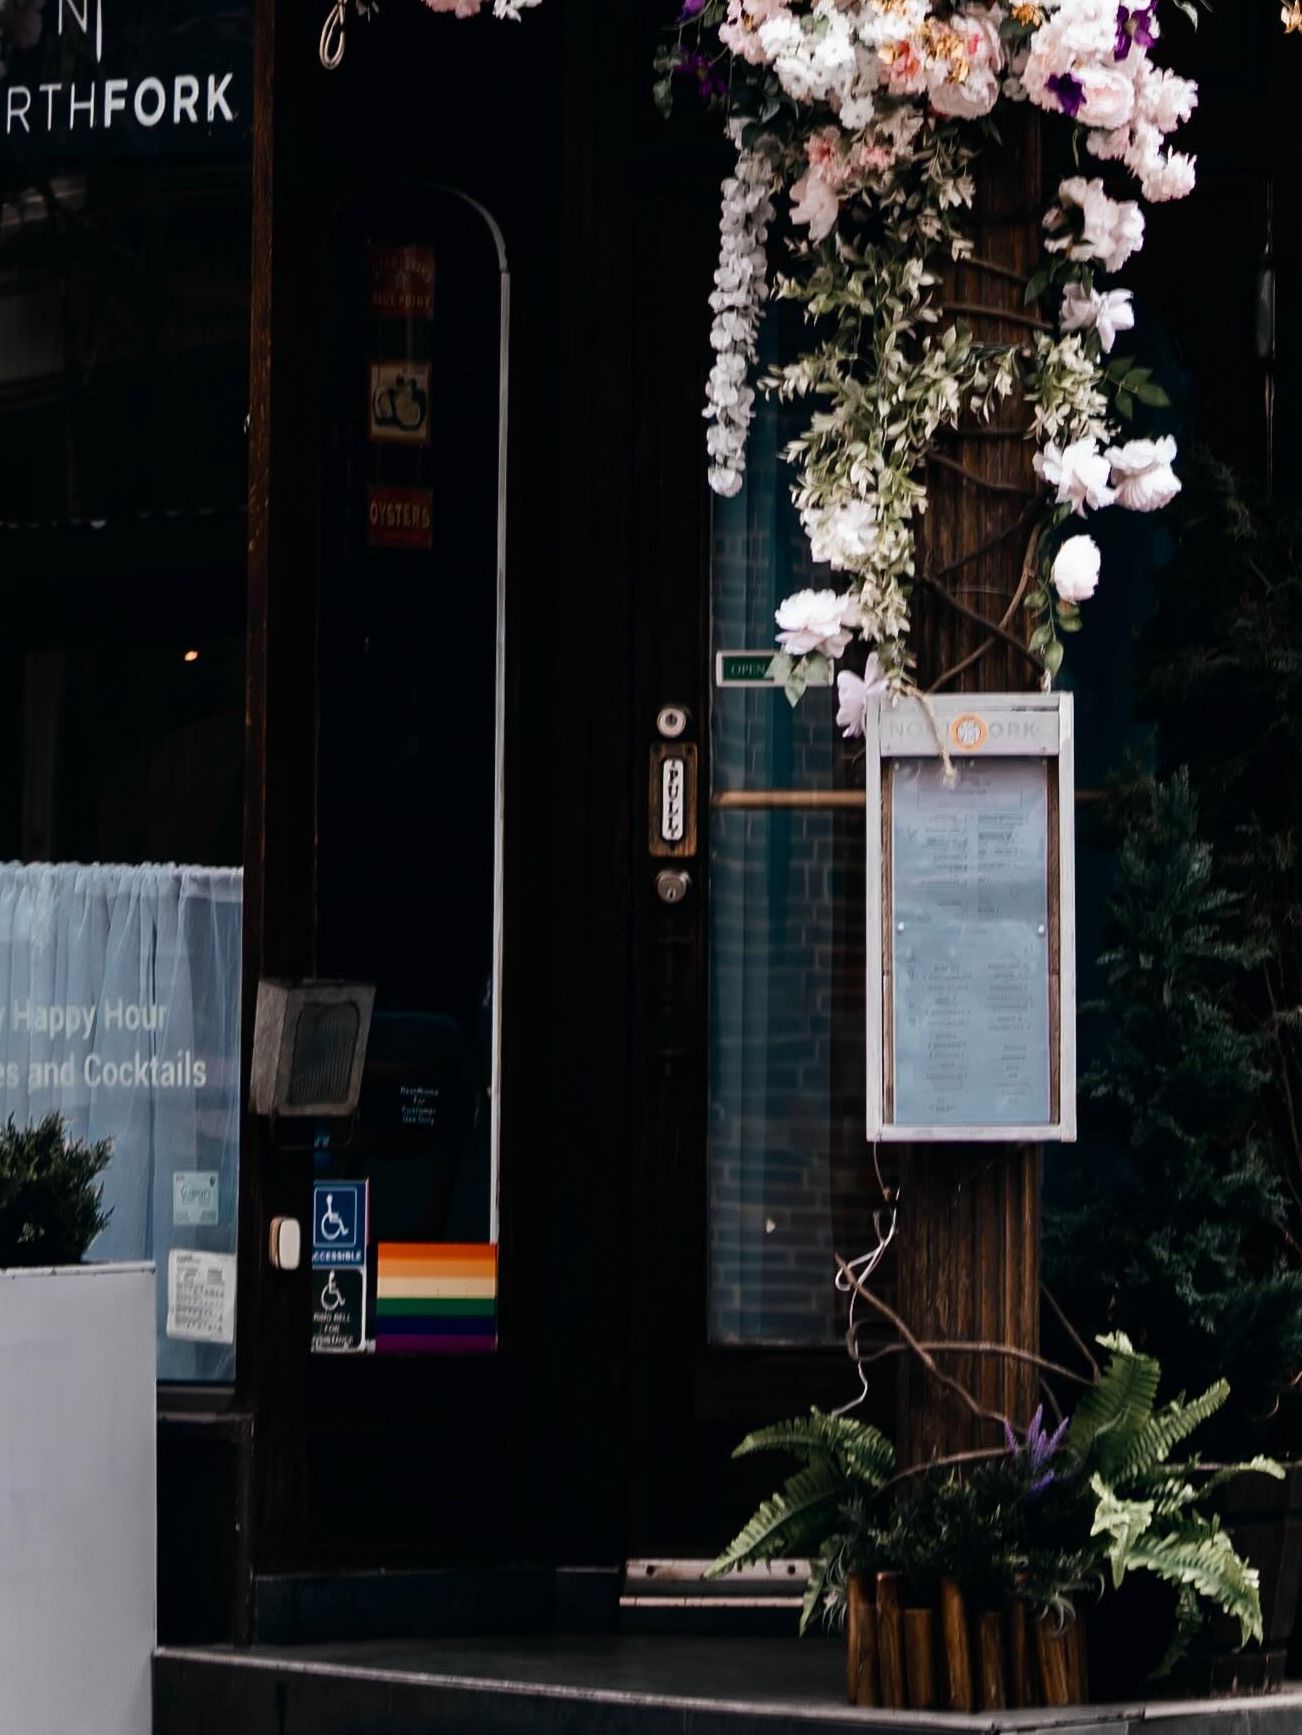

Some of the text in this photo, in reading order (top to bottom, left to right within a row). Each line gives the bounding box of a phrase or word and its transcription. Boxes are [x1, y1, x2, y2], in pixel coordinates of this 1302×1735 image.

[370, 501, 431, 531] OYSTERS
[730, 662, 766, 676] OPEN
[667, 769, 680, 838] PULL
[12, 1001, 96, 1041] Happy
[104, 1000, 169, 1032] Hour
[28, 1051, 75, 1088] and
[84, 1049, 207, 1088] Cocktails
